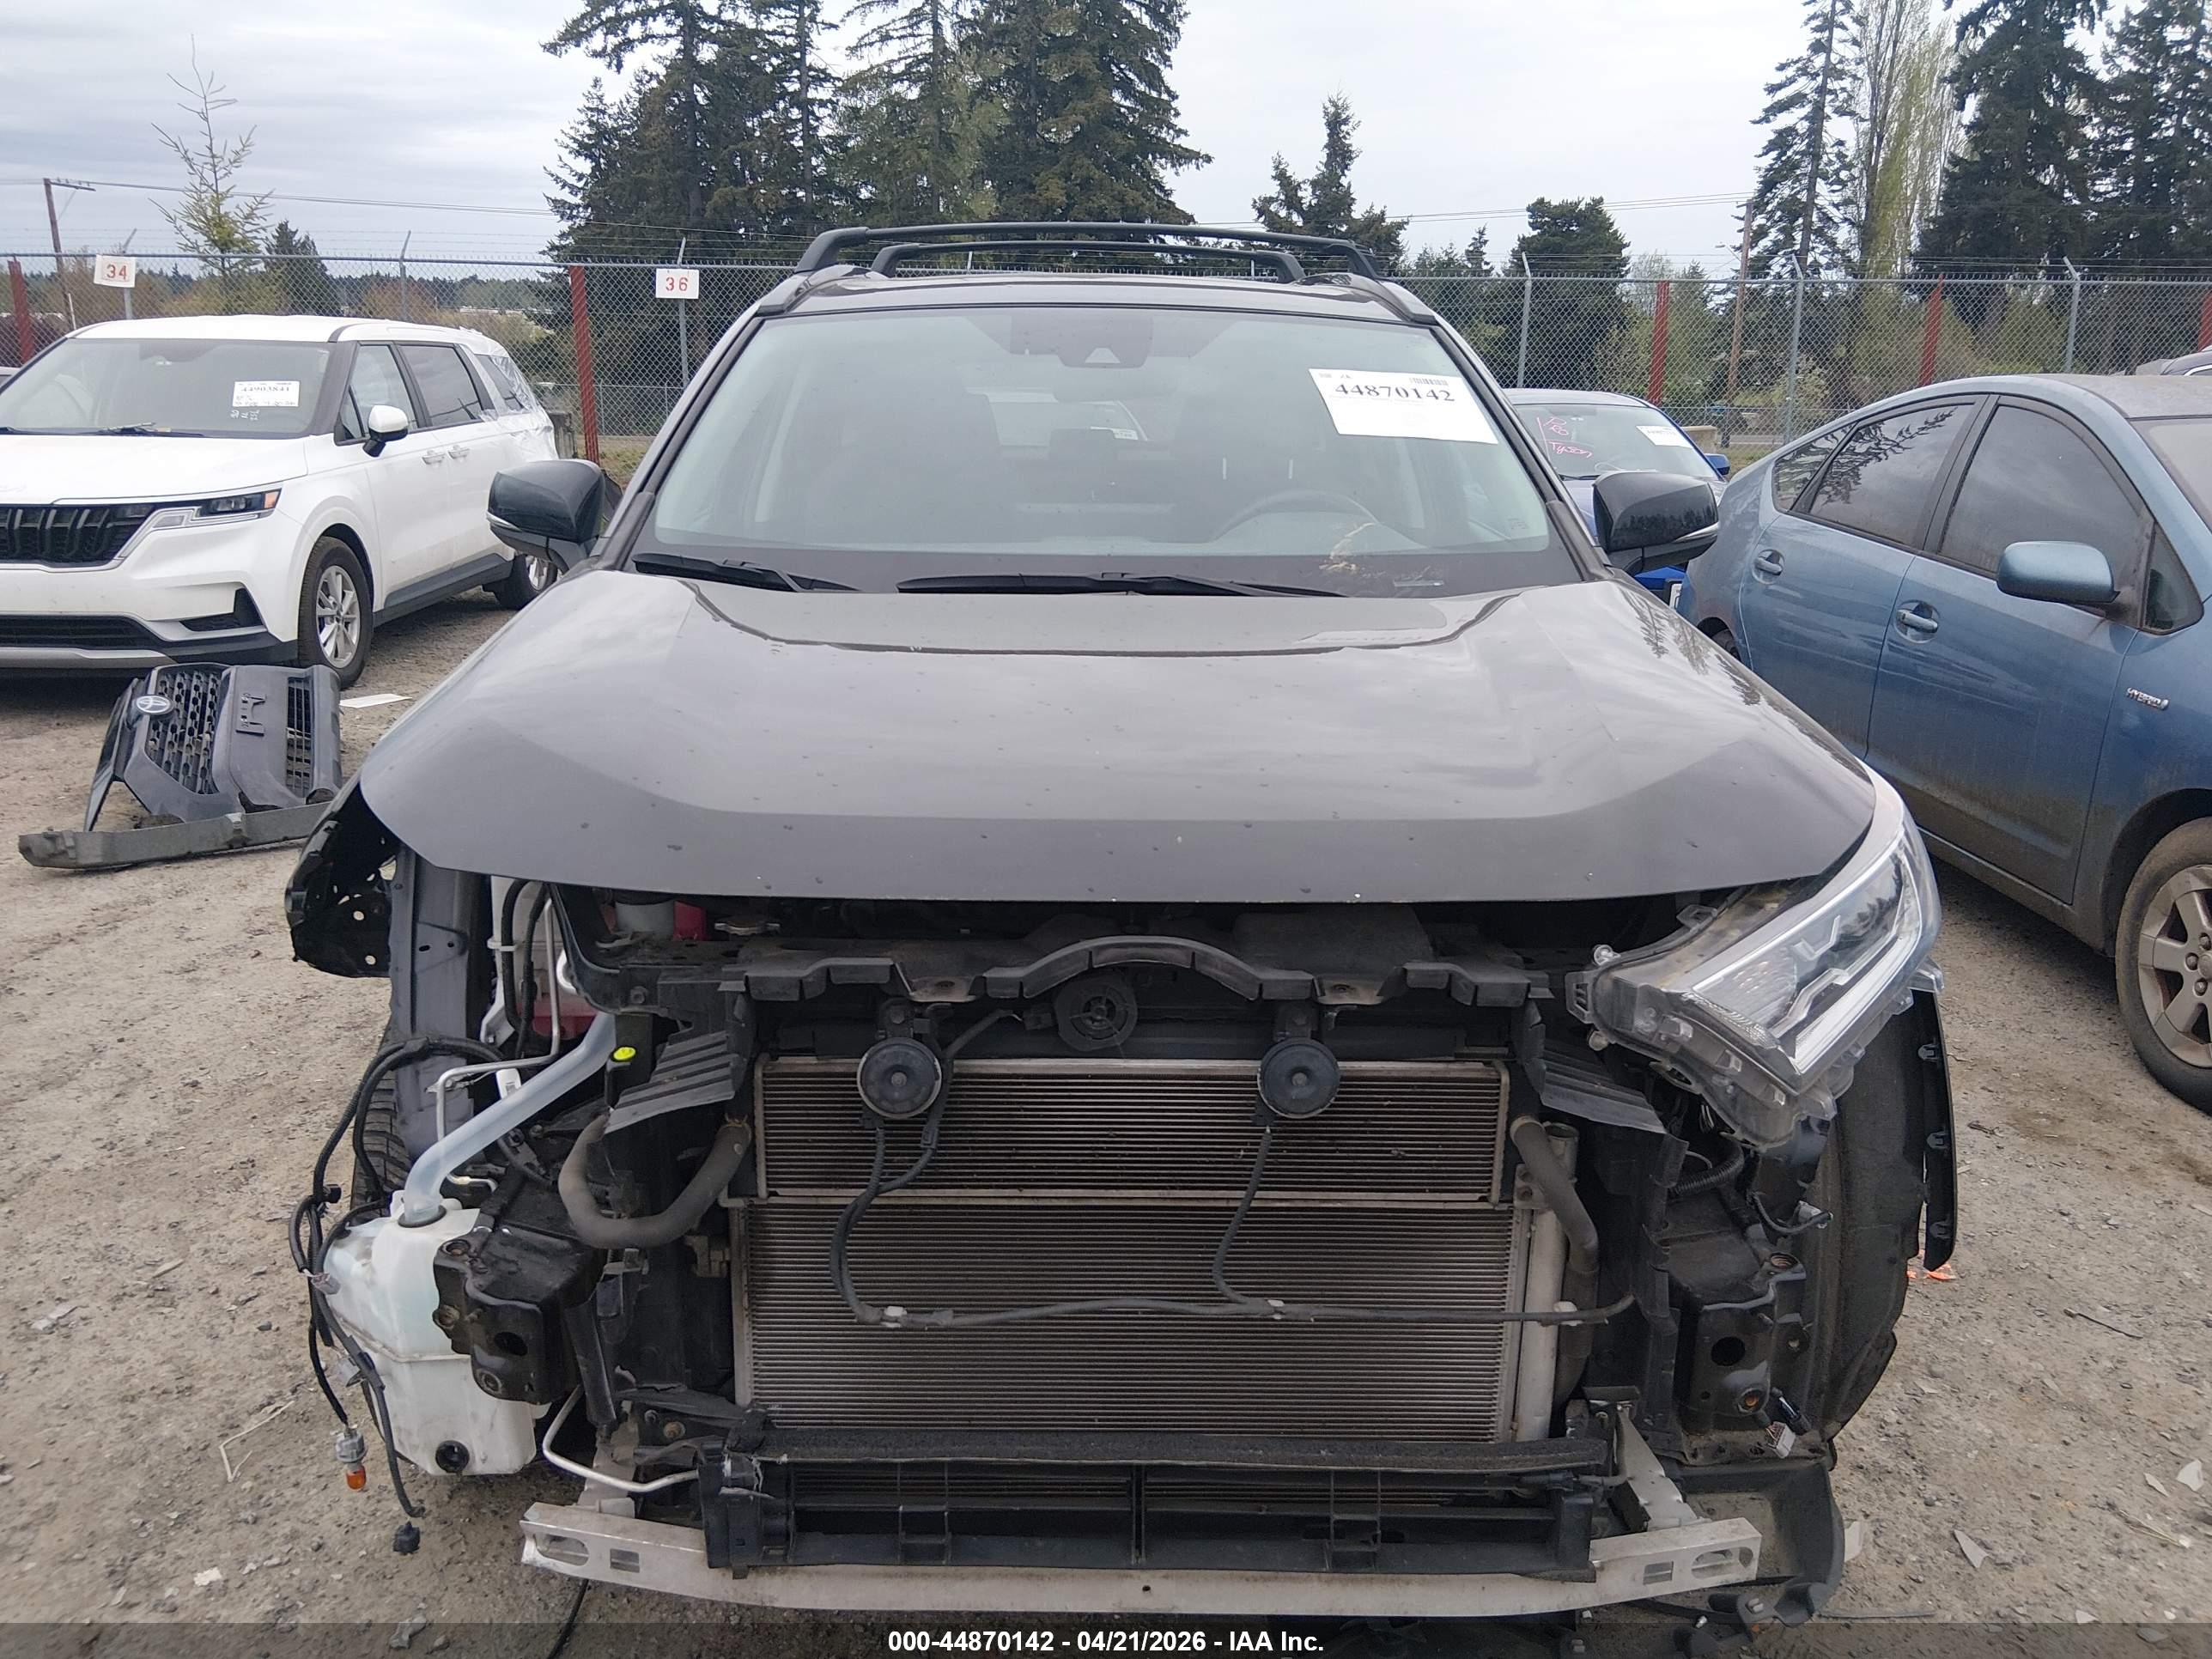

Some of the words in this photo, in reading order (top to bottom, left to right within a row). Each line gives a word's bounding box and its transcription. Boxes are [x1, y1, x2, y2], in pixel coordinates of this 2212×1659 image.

[106, 264, 127, 280] 34
[665, 276, 689, 291] 36
[1335, 384, 1455, 402] 44870142
